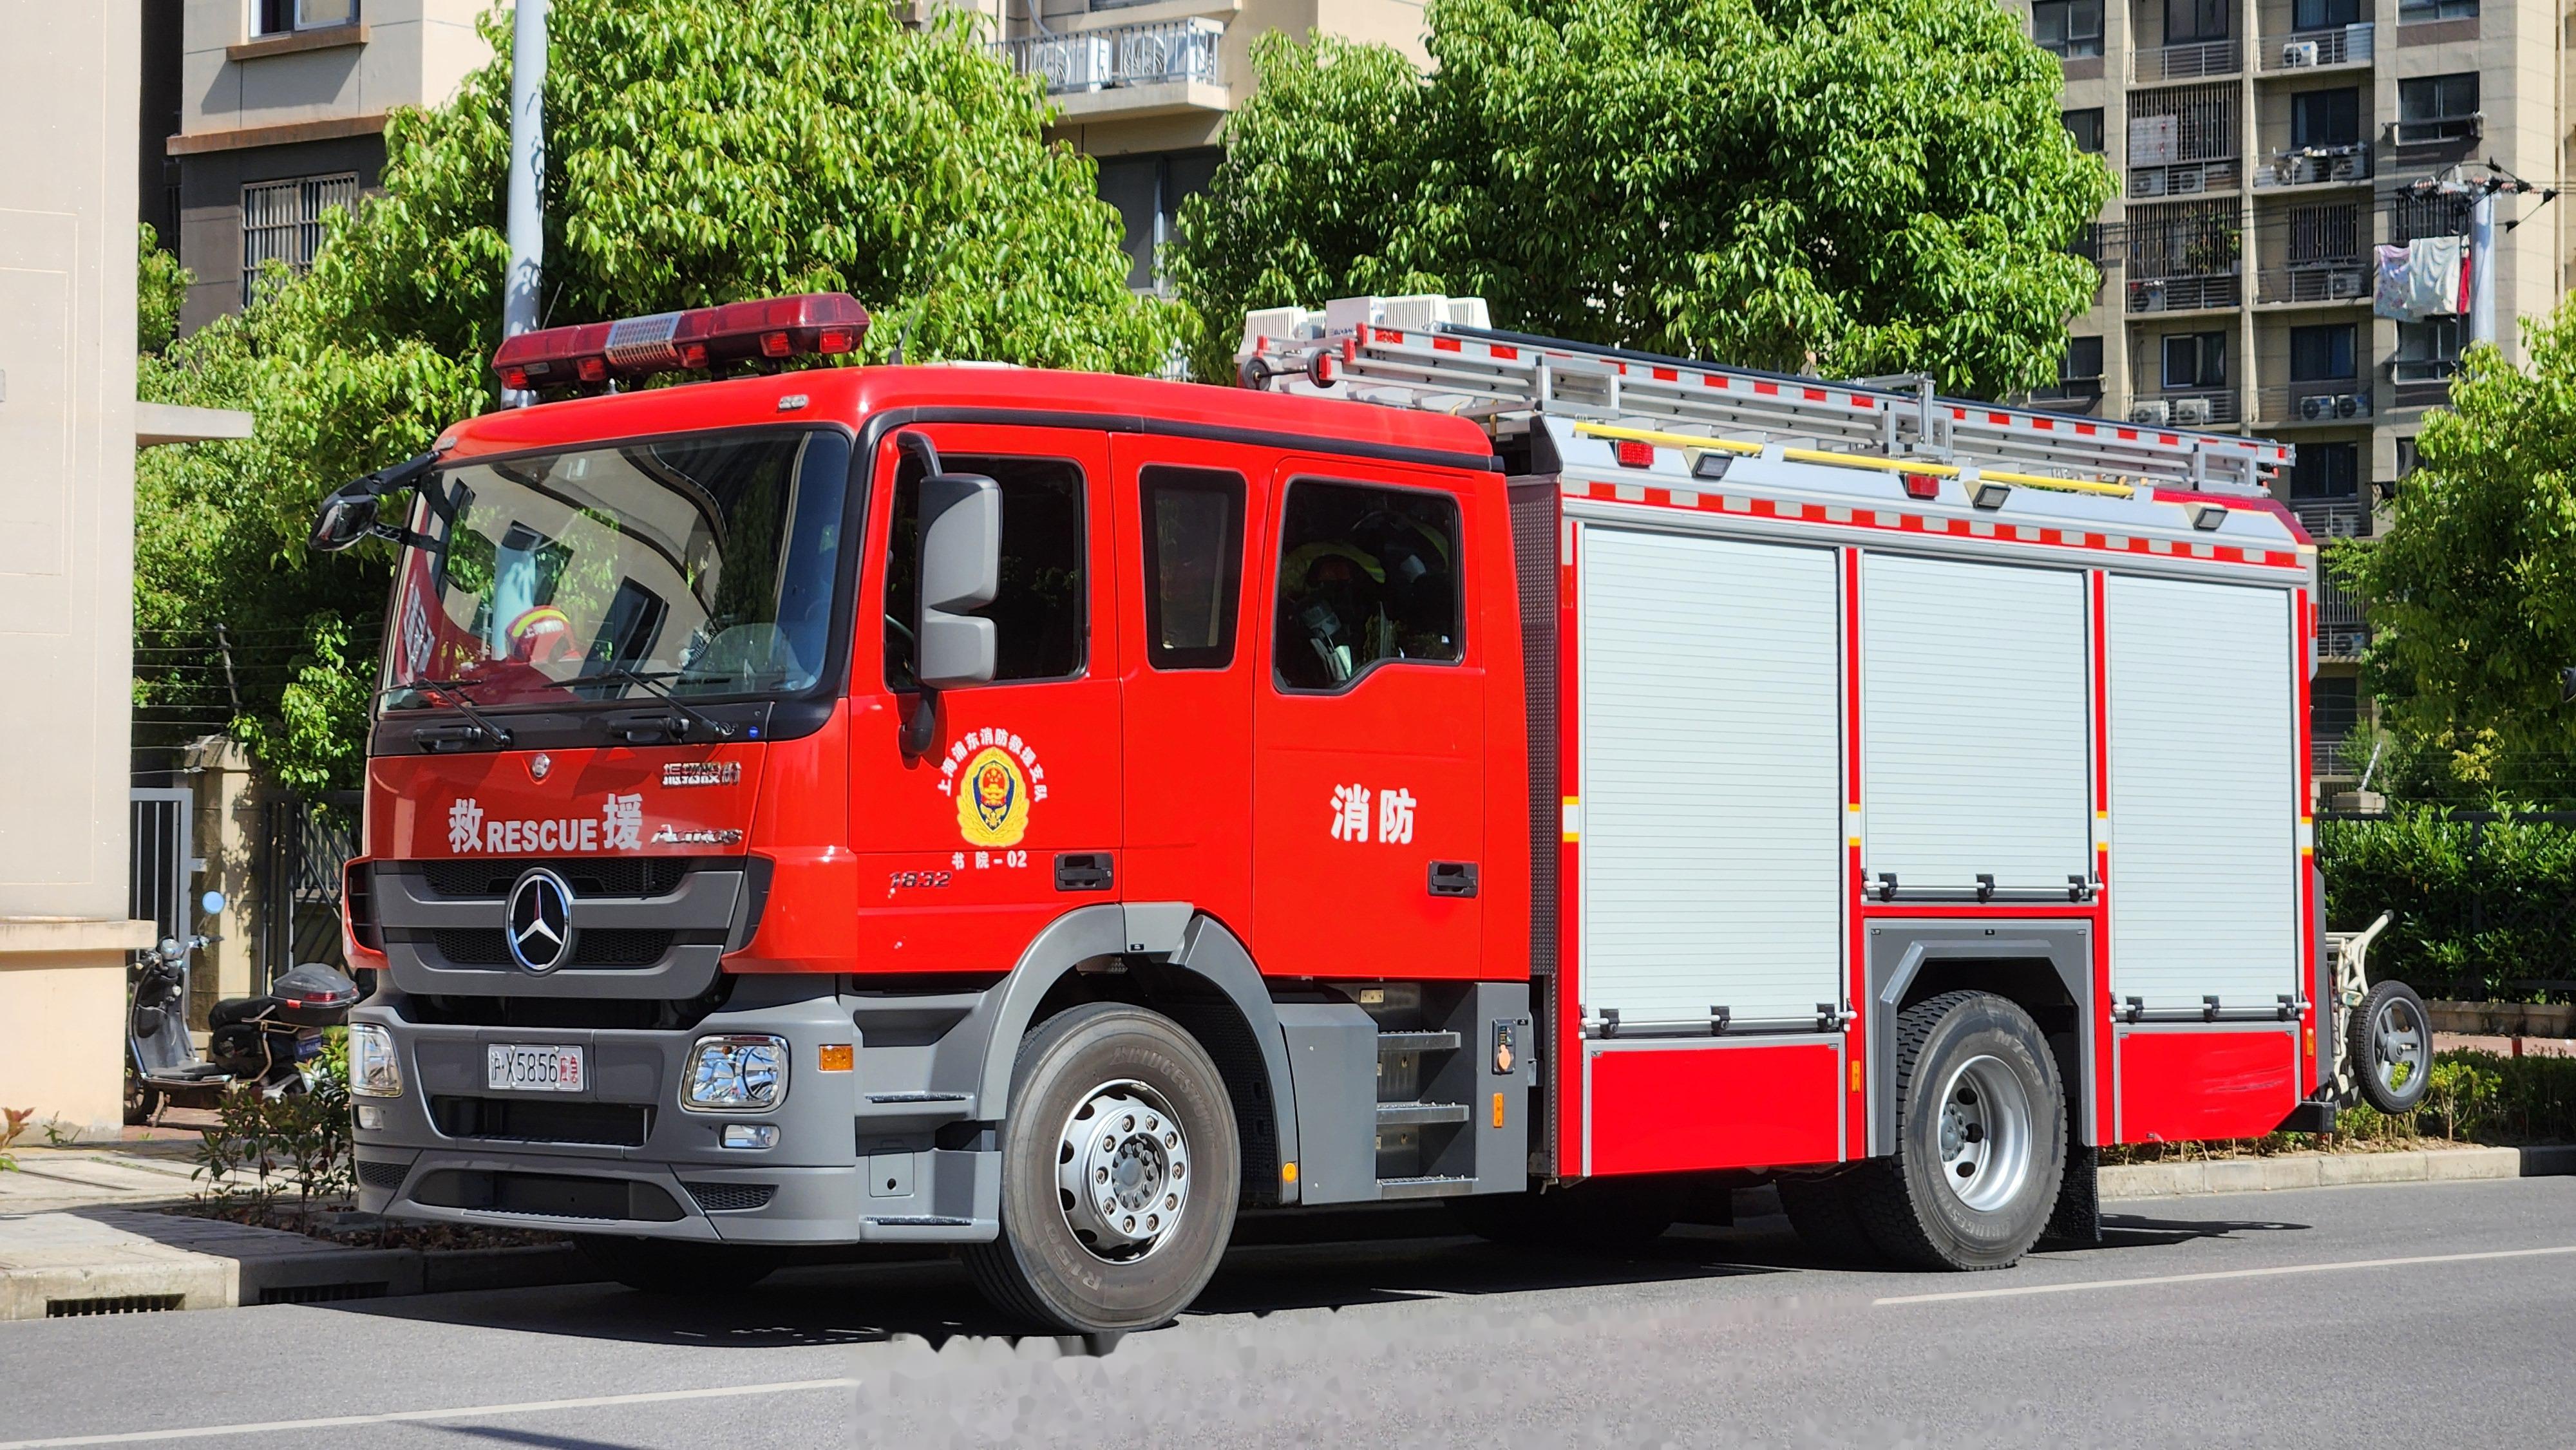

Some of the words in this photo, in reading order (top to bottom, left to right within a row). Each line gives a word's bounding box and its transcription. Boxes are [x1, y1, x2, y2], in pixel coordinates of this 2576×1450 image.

[938, 727, 1048, 802] 上海浦东消防救援支队
[448, 798, 484, 853] 救
[487, 819, 598, 853] RESCUE
[602, 793, 643, 851] 援
[1330, 784, 1417, 844] 消防
[889, 871, 952, 889] 1832
[1045, 1222, 1103, 1291] R150
